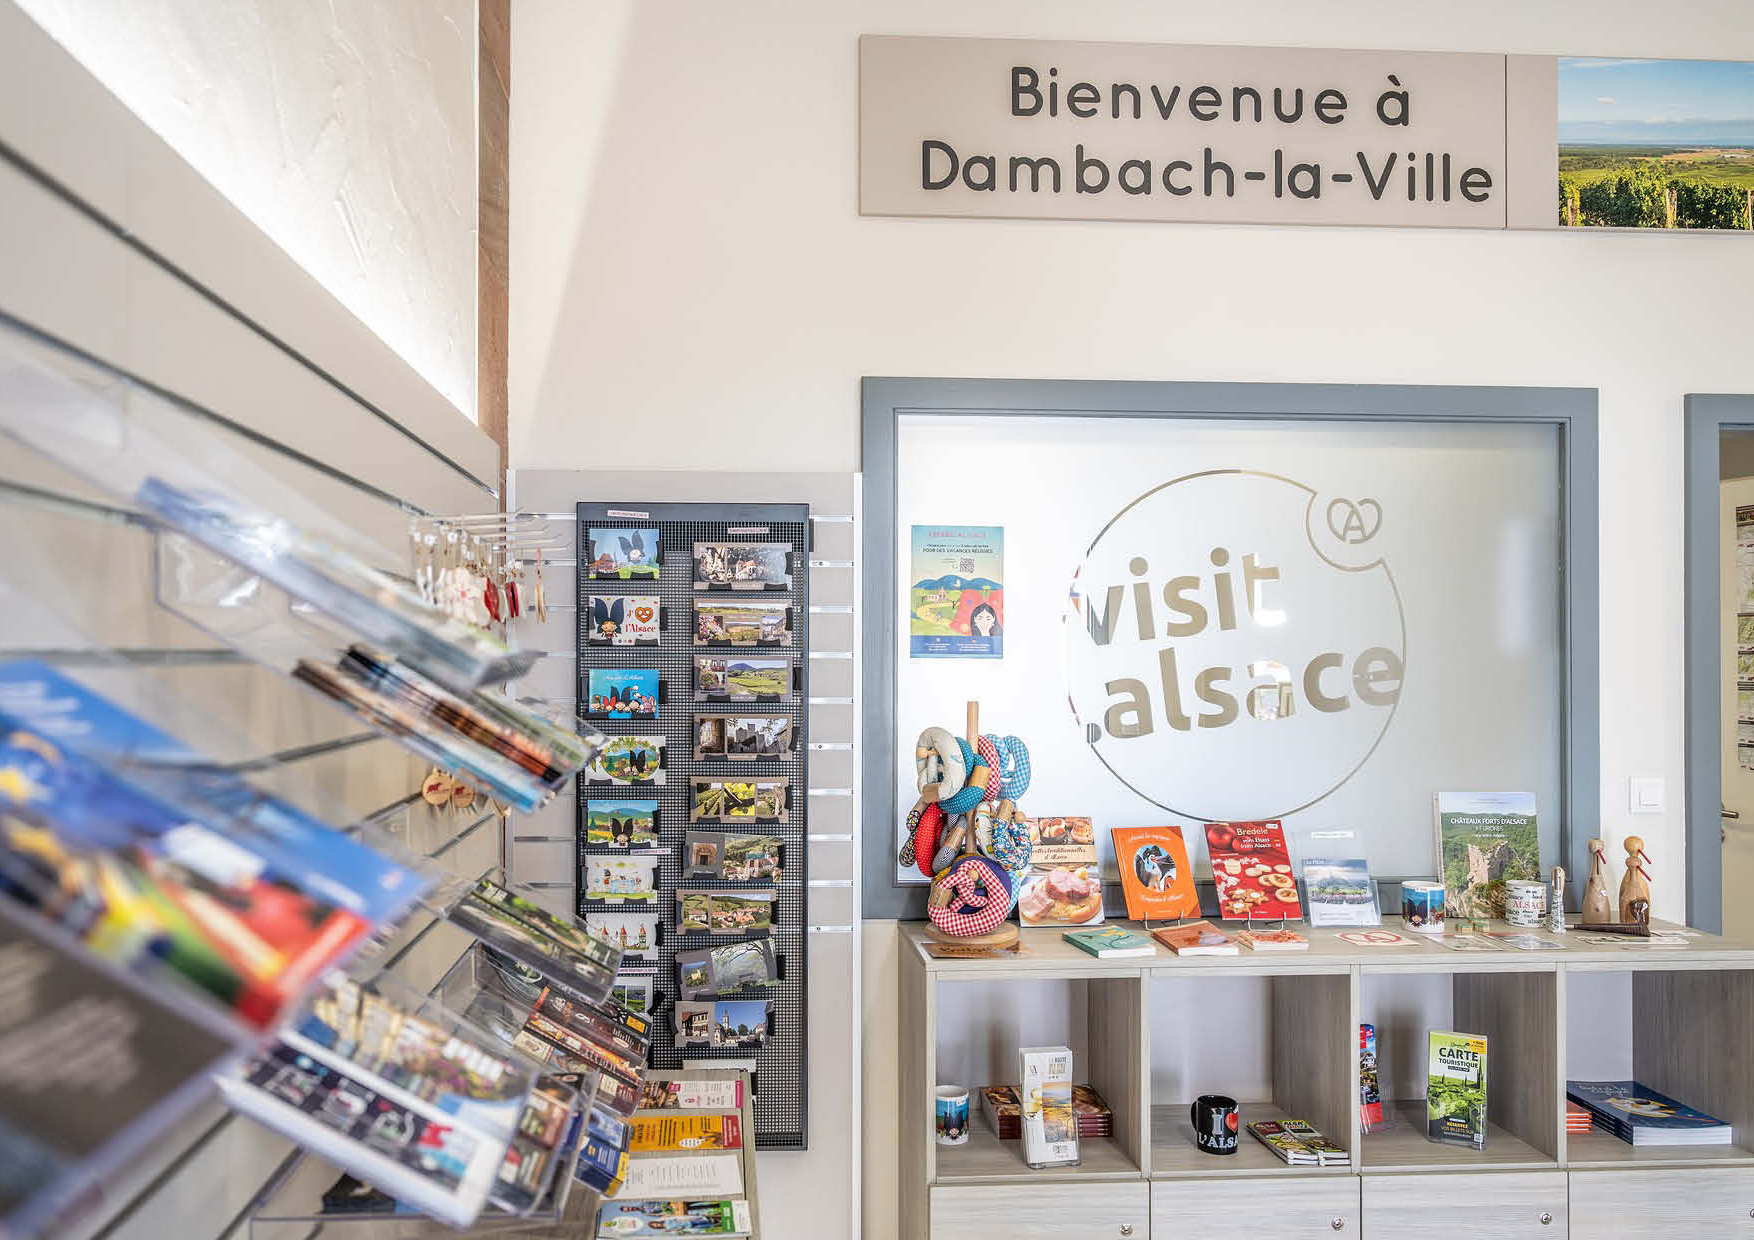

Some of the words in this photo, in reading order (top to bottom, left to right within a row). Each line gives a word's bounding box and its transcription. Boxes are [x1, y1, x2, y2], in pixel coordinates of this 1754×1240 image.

[1011, 65, 1349, 125] Bienvenue
[1376, 73, 1411, 128] à
[921, 139, 1494, 203] Dambach-la-Ville
[1068, 546, 1287, 646] visit
[1236, 827, 1269, 836] Bredele
[1438, 1047, 1479, 1062] CARTE
[1438, 1057, 1479, 1069] TOURISTIQUE
